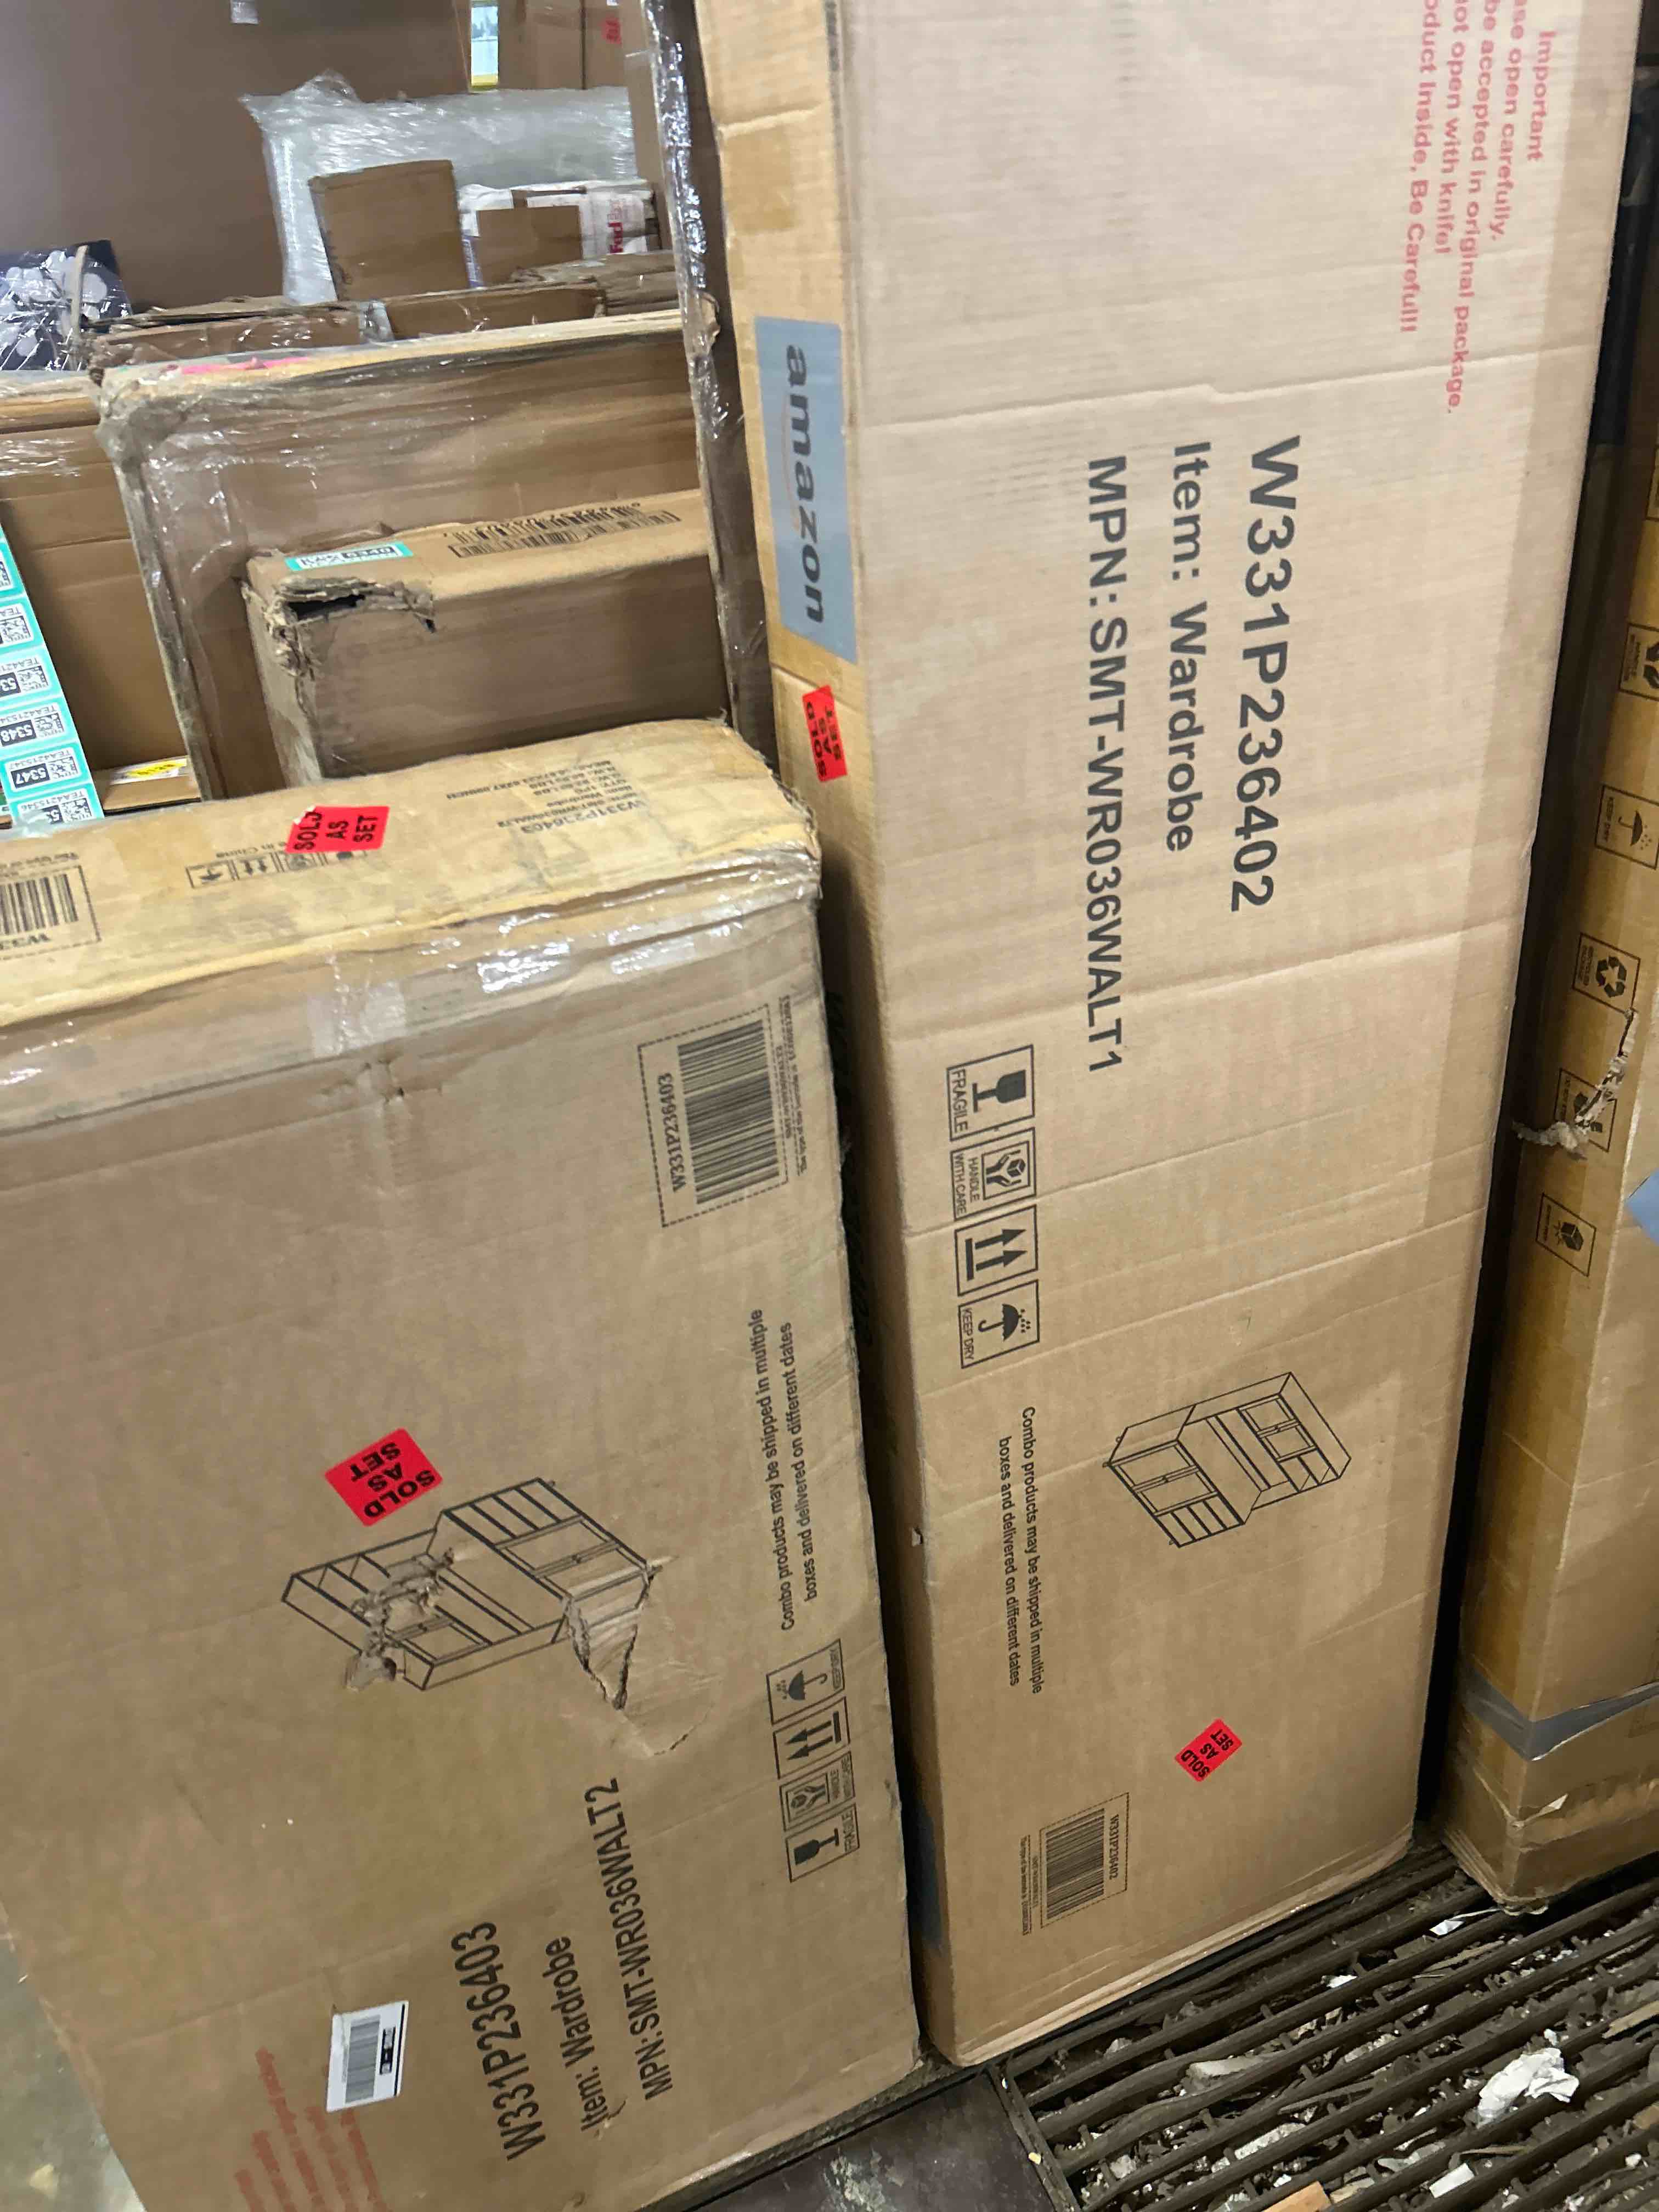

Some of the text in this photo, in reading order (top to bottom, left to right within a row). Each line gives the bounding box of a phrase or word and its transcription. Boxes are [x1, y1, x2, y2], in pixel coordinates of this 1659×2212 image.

[1452, 0, 1470, 33] ot
[1446, 42, 1465, 109] open
[1471, 39, 1494, 162] accepted
[1503, 48, 1522, 114] open
[1527, 31, 1558, 161] Important
[1441, 117, 1462, 174] with
[1408, 179, 1430, 215] Be
[1469, 167, 1486, 195] in
[1457, 200, 1481, 299] original
[1445, 305, 1471, 414] package.
[786, 345, 825, 623] amazon
[1166, 441, 1212, 852] Item: Wardrobe
[1231, 435, 1301, 912] W331P236402
[15, 768, 47, 785] 5347
[326, 820, 350, 840] AS
[352, 815, 379, 843] SET
[658, 1071, 687, 1193] W331P236403
[951, 1068, 968, 1133] FRAGILE
[962, 1307, 974, 1361] KEEP DRY
[350, 1442, 400, 1482] SET
[364, 1470, 435, 1517] SOLD
[368, 1462, 403, 1492] AS
[748, 1308, 795, 1631] Combo products may be shipped in multiple
[780, 1322, 817, 1602] boxes and delivered on different dates
[999, 1436, 1021, 1688] boxes and delivered on different dates
[1022, 1406, 1045, 1695] Combo products may be shipped in multiple
[1181, 1750, 1210, 1778] SOLD
[1200, 1743, 1220, 1759] AS
[1210, 1729, 1234, 1751] SET
[1109, 1814, 1119, 1880] W331P236402
[450, 1922, 546, 2162] W331P236403
[542, 1936, 609, 2131] Item: Wardrobe
